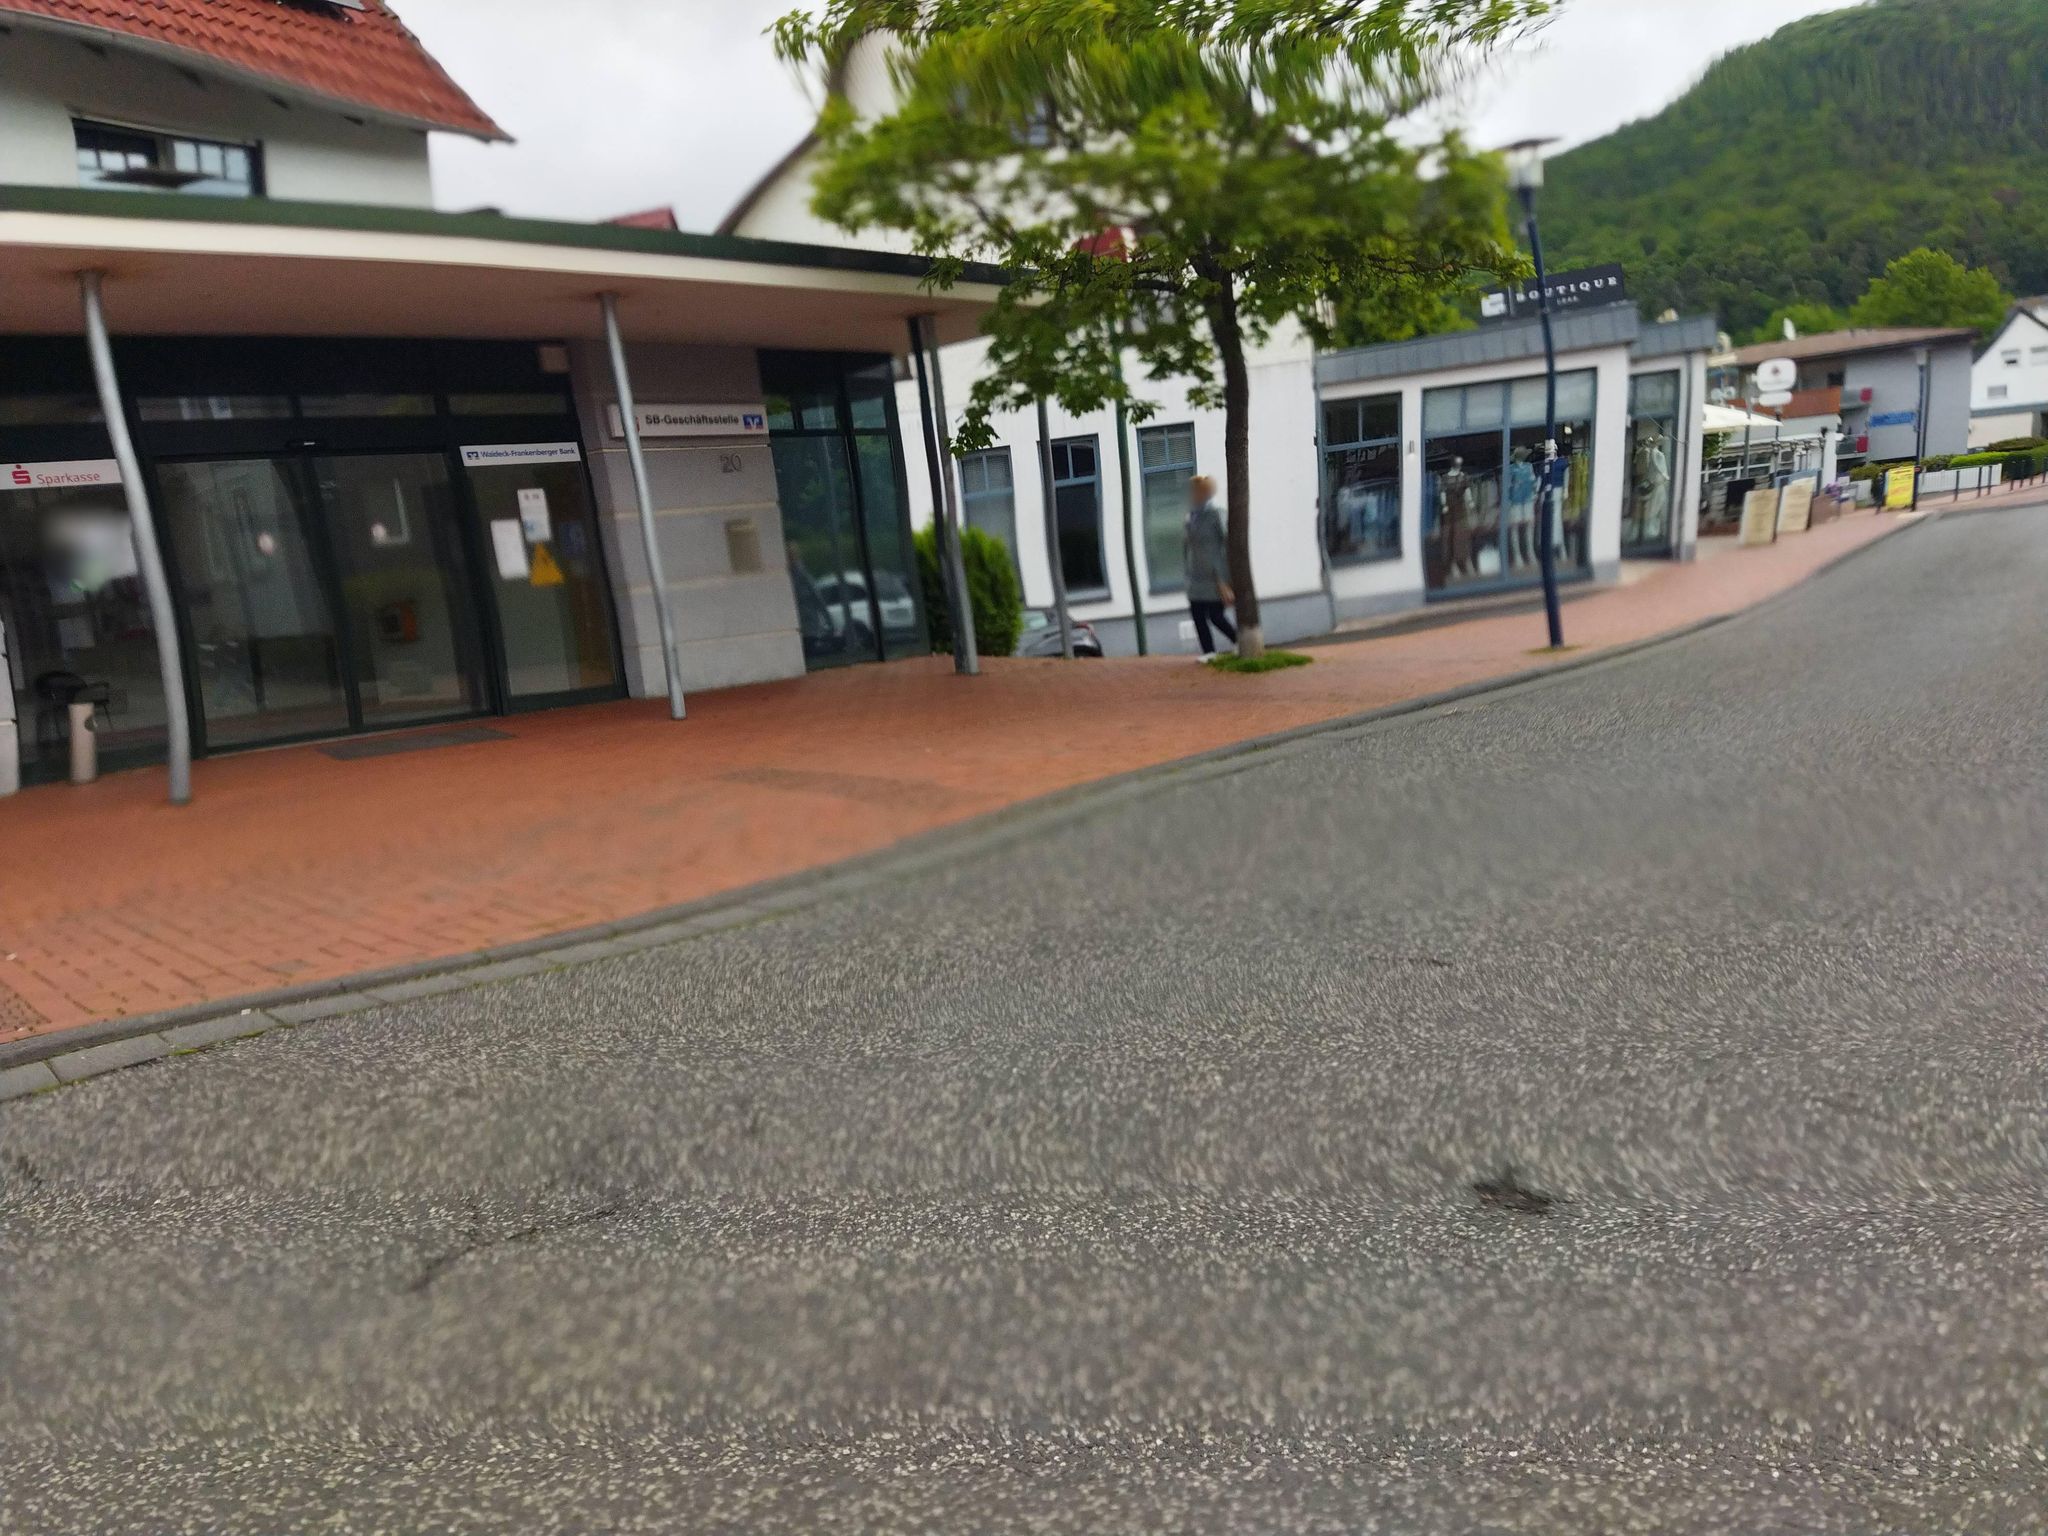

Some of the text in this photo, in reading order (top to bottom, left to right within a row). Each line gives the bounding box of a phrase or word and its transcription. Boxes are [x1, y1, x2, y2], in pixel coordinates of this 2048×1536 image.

[645, 414, 739, 425] SB-Geschäftsstelle
[481, 449, 558, 457] Waldeck-Frankenberger
[719, 452, 742, 473] 20
[36, 473, 100, 486] Sparkasse
